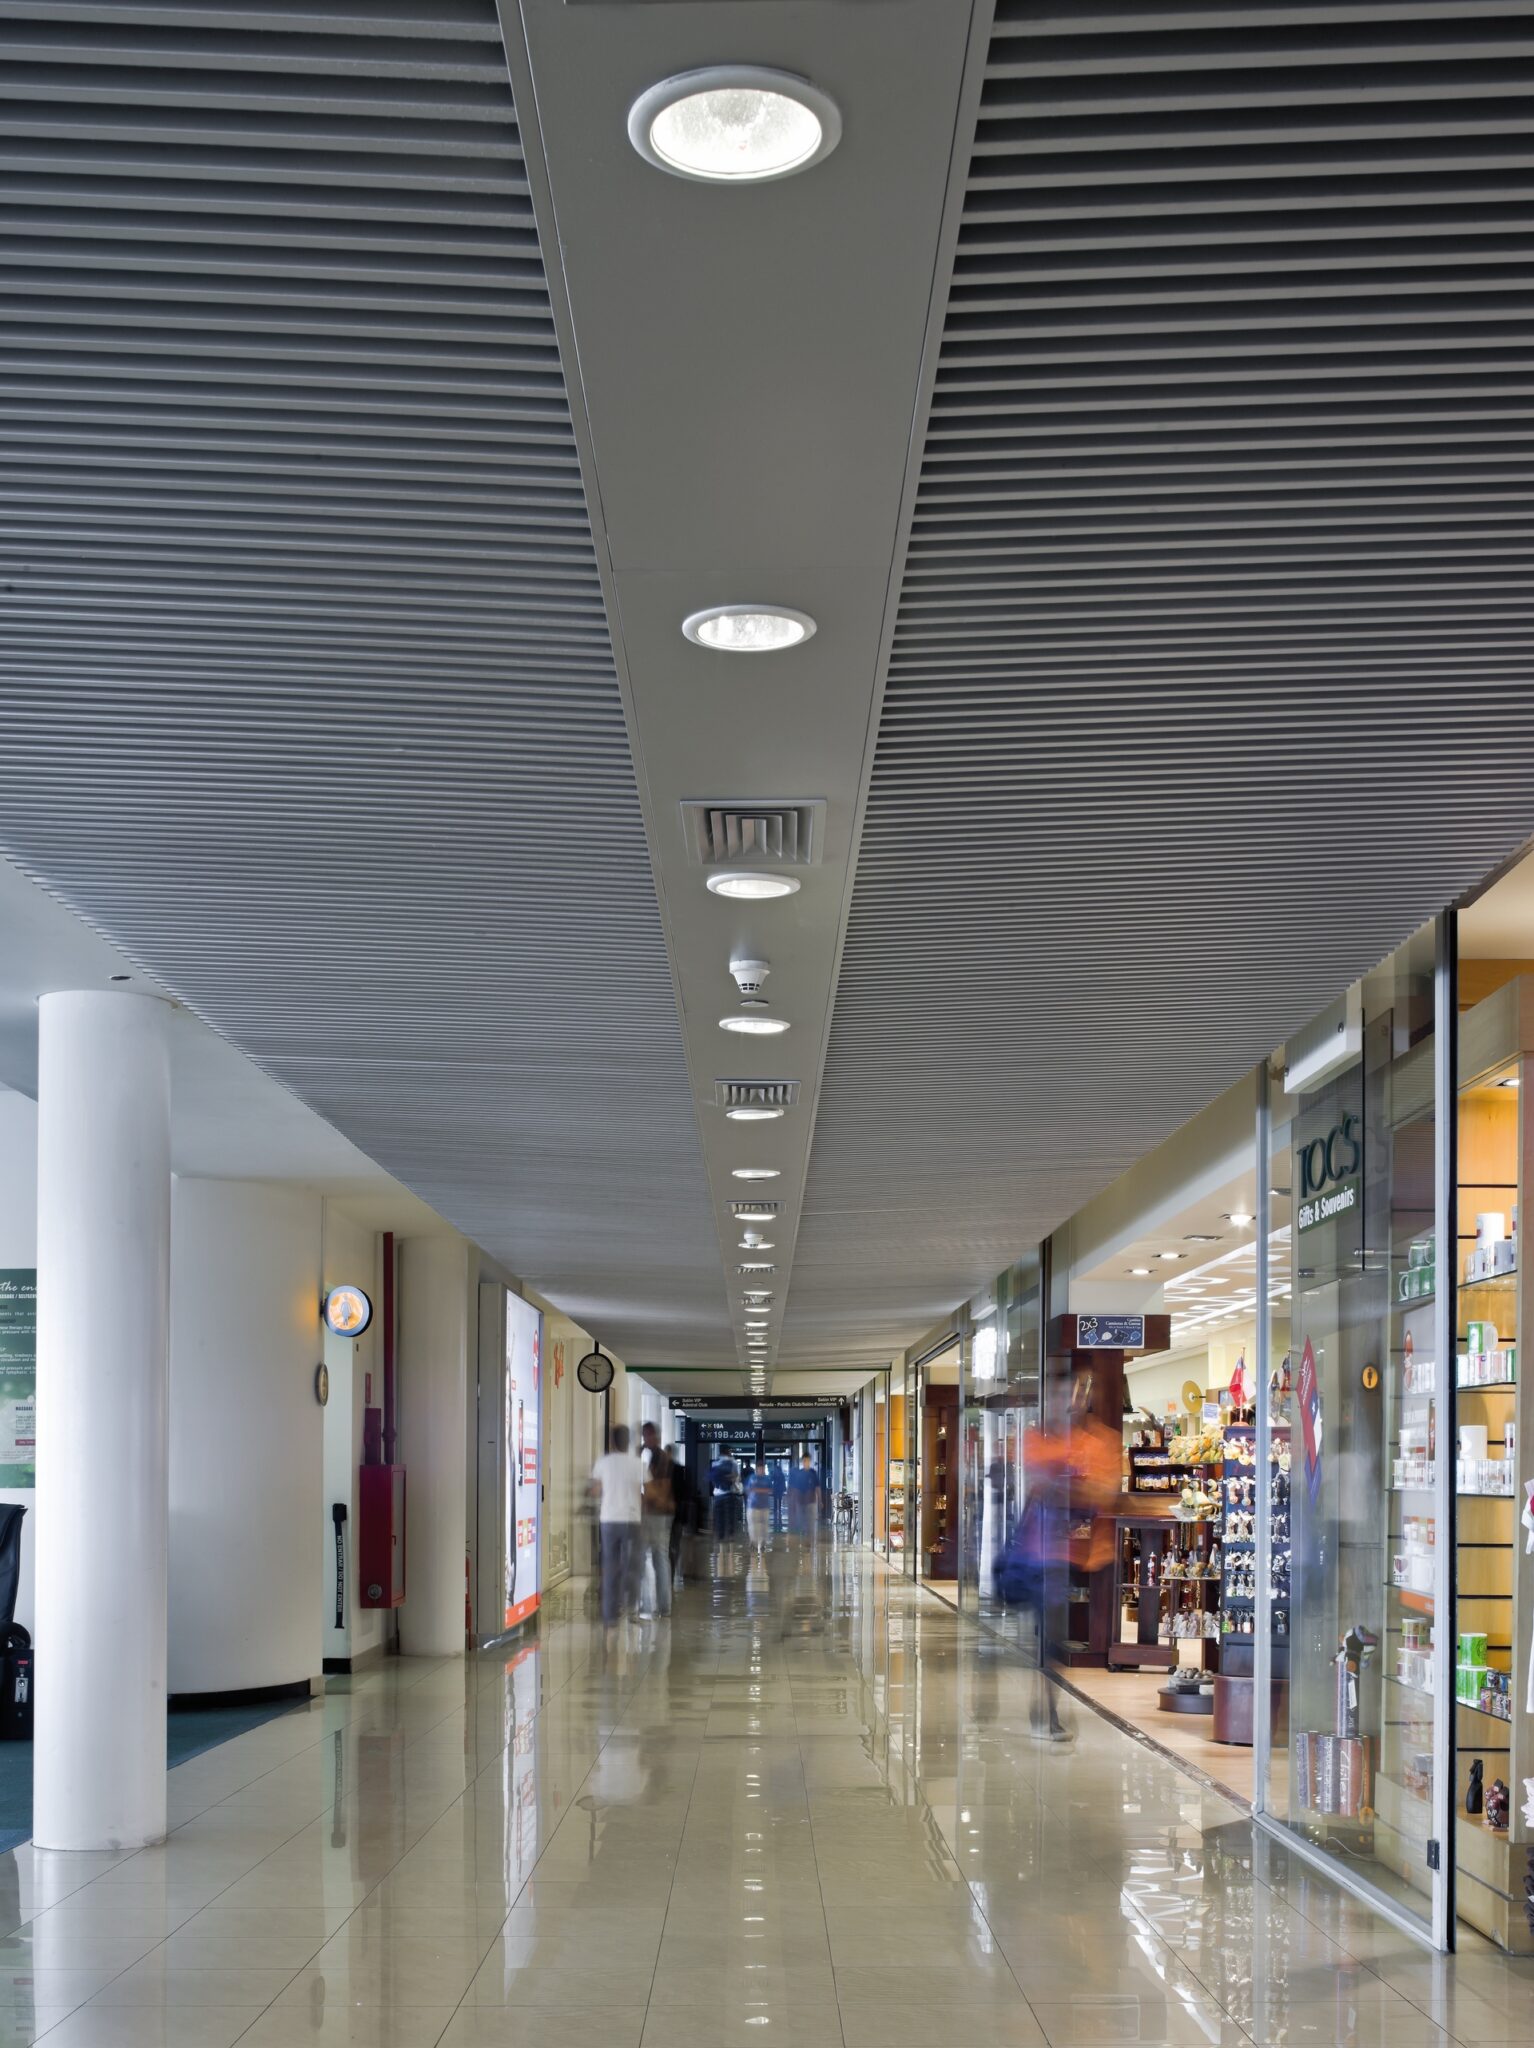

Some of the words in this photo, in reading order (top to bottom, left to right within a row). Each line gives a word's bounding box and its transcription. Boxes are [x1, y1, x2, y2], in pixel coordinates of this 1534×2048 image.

[1299, 1204, 1314, 1229] Gifts
[1314, 1200, 1320, 1222] &
[1321, 1186, 1354, 1219] Souvenirs
[1080, 1317, 1098, 1331] 2x3
[336, 1535, 344, 1545] NO
